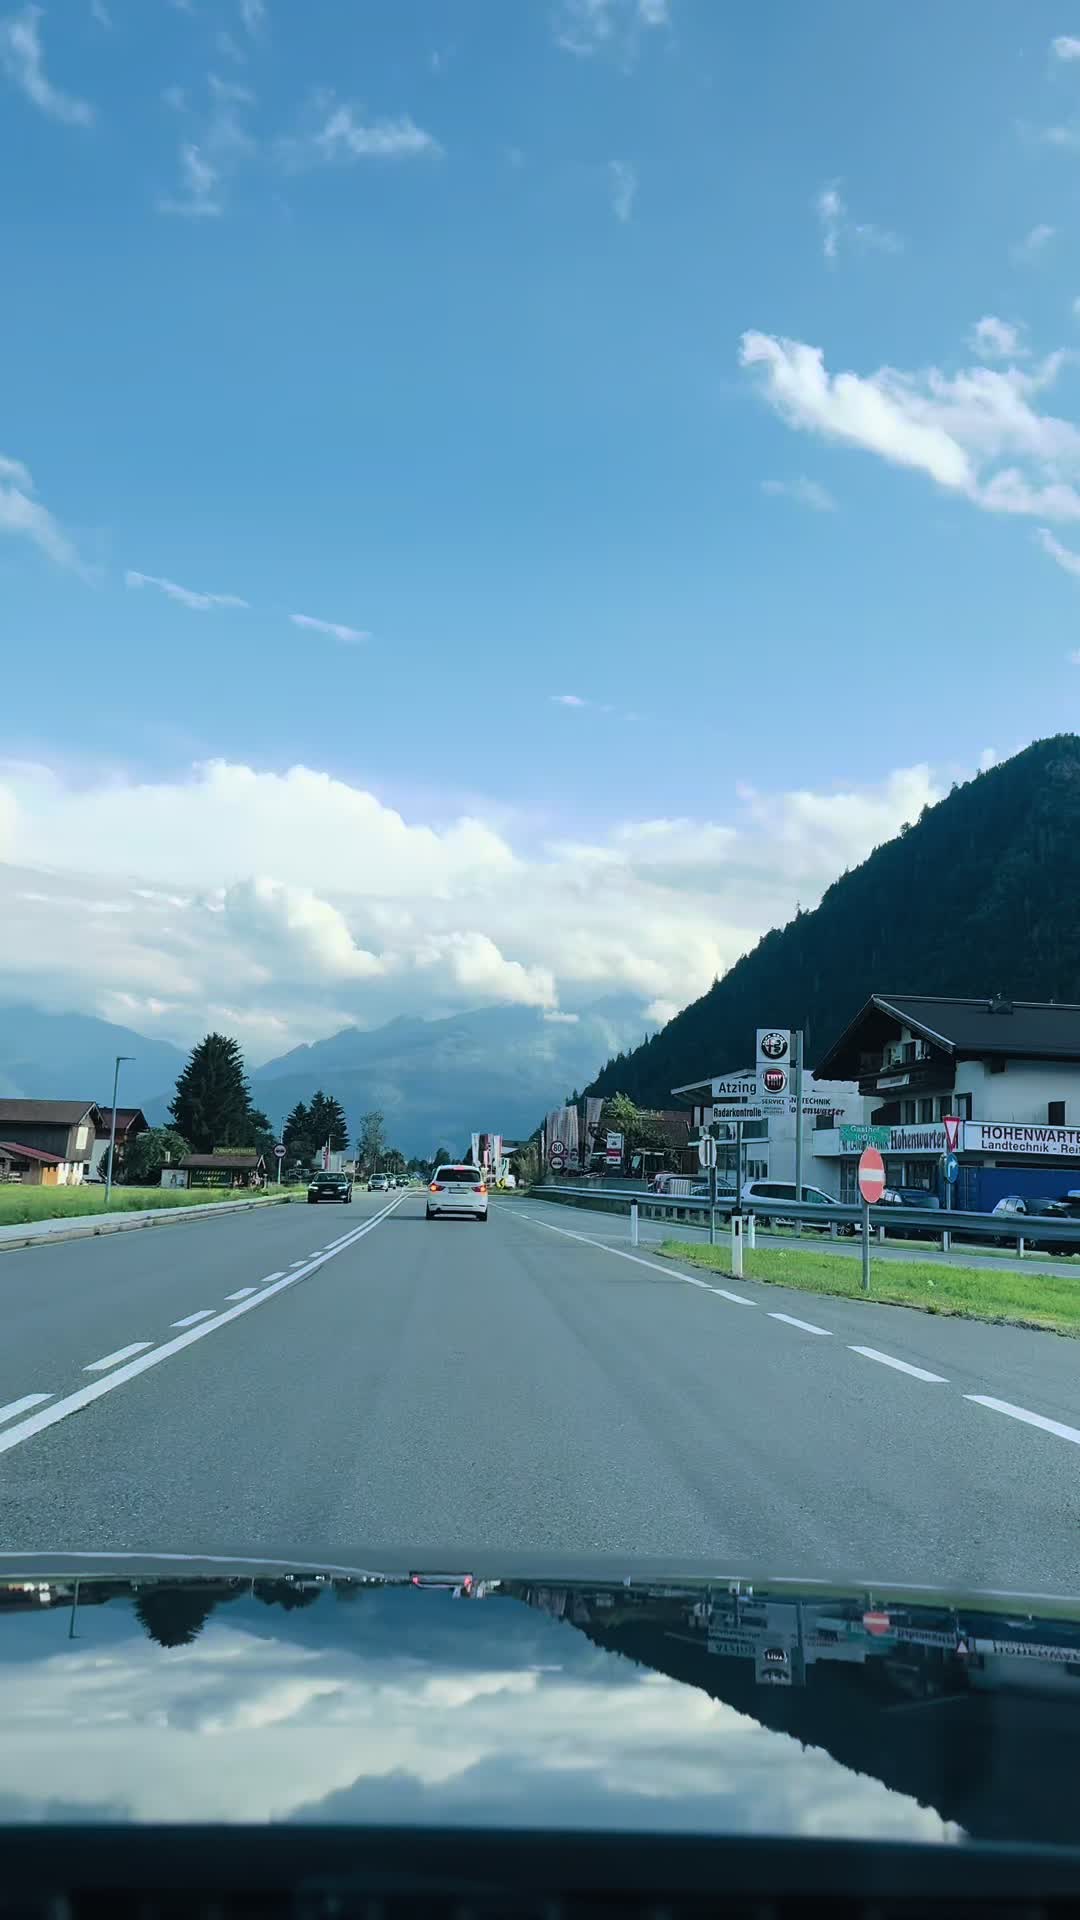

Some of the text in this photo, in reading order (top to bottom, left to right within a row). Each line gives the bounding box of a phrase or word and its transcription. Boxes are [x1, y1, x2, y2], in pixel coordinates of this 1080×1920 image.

[766, 1074, 782, 1086] FIAT
[719, 1081, 757, 1096] Atzing
[713, 1108, 762, 1118] Radarkontrolle
[789, 1106, 845, 1117] oenwarter
[890, 1129, 946, 1151] Hohenwarter
[553, 1142, 561, 1152] 80
[981, 1140, 1049, 1153] Landtechnik
[1060, 1144, 1080, 1154] Rei
